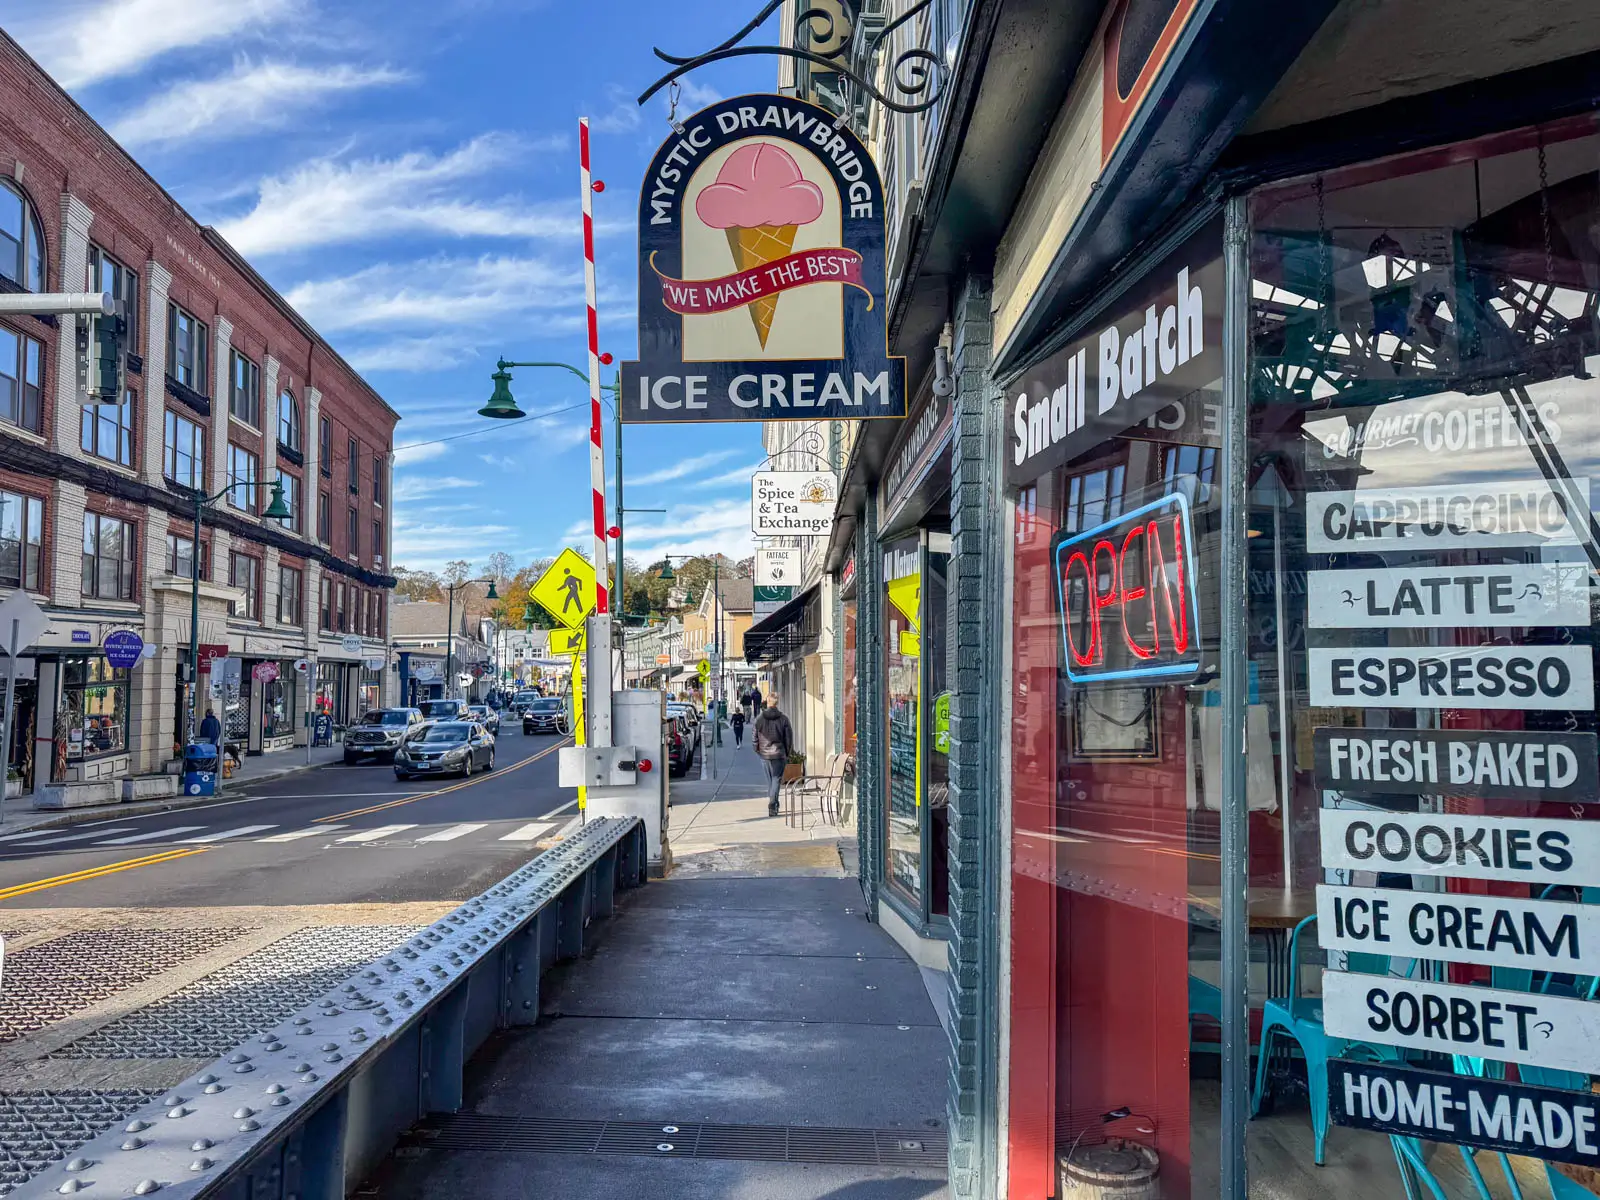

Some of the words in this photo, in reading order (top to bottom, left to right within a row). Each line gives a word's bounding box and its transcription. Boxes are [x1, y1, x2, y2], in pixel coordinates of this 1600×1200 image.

[650, 125, 711, 225] MYSTIC
[715, 105, 873, 219] DRAWBRIDGE
[704, 275, 762, 307] MAKE
[765, 259, 803, 288] THE
[639, 375, 708, 410] ICE
[727, 371, 890, 409] CREAM
[1014, 347, 1086, 466] Small
[1098, 265, 1204, 416] Batch
[1322, 413, 1425, 459] GOURMET
[1423, 402, 1562, 451] COFFEES
[757, 479, 774, 487] The
[758, 488, 795, 502] Spice
[758, 502, 771, 514] &
[774, 502, 799, 514] Tea
[758, 516, 829, 532] Exchange
[1323, 491, 1568, 541] CAPPUCCINO
[766, 552, 789, 560] FATFACE
[1064, 514, 1188, 667] OPEN
[1366, 575, 1516, 616] LATTE
[1331, 657, 1572, 697] ESPRESSO
[1329, 738, 1439, 783] FRESH
[1450, 742, 1579, 788] BAKED
[1345, 820, 1574, 872] COOKIES
[1334, 897, 1391, 942] ICE
[1408, 902, 1580, 960] CREAM
[1366, 988, 1538, 1051] SORBET
[1343, 1072, 1599, 1156] HOME-MADE
